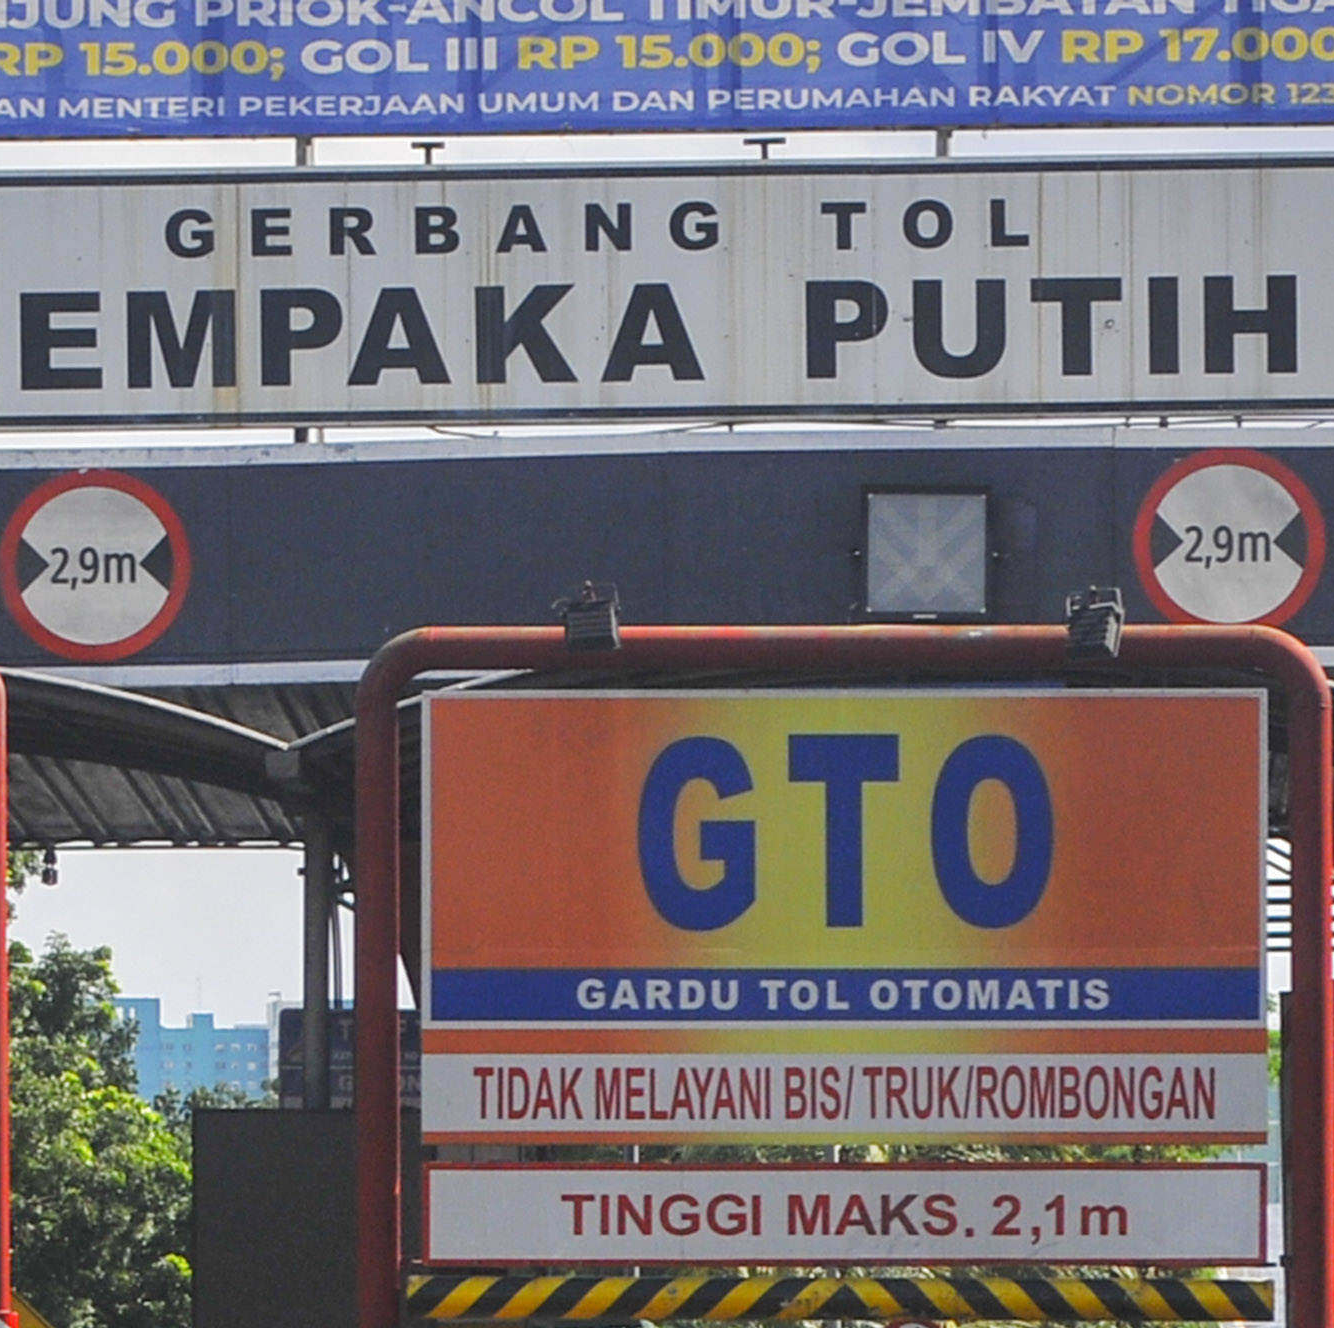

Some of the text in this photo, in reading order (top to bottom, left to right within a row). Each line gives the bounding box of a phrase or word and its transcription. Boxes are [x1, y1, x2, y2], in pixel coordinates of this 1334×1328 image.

[195, 0, 624, 28] PRIOK-ANCOL
[79, 41, 286, 80] 15.000;
[300, 40, 429, 75] GOL
[446, 38, 498, 70] III
[517, 37, 600, 69] RP
[616, 32, 822, 72] 15.000;
[836, 31, 966, 66] GOL
[983, 30, 1045, 63] IV
[1060, 29, 1144, 62] RP
[58, 95, 226, 119] MENTERI
[238, 93, 465, 117] PEKERJAAN
[478, 91, 600, 112] UMUM
[612, 89, 695, 112] DAN
[708, 86, 956, 110] PERUMAHAN
[969, 84, 1116, 107] RAKYAT
[1127, 82, 1275, 106] NOMOR
[163, 197, 1031, 261] GERBANG TOL
[803, 272, 1300, 382] PUTIH
[50, 546, 137, 591] 2,9m
[1184, 525, 1272, 569] 2,9m
[637, 732, 1055, 932] GTO
[576, 976, 1111, 1012] GARDU TOL OTOMATIS
[473, 1066, 584, 1122] TIDAK
[594, 1065, 771, 1122] MELAYANI
[863, 1064, 1217, 1122] TRUK/ROMBONGAN
[560, 1194, 763, 1237] TINGGI
[787, 1193, 976, 1238] MAKS.
